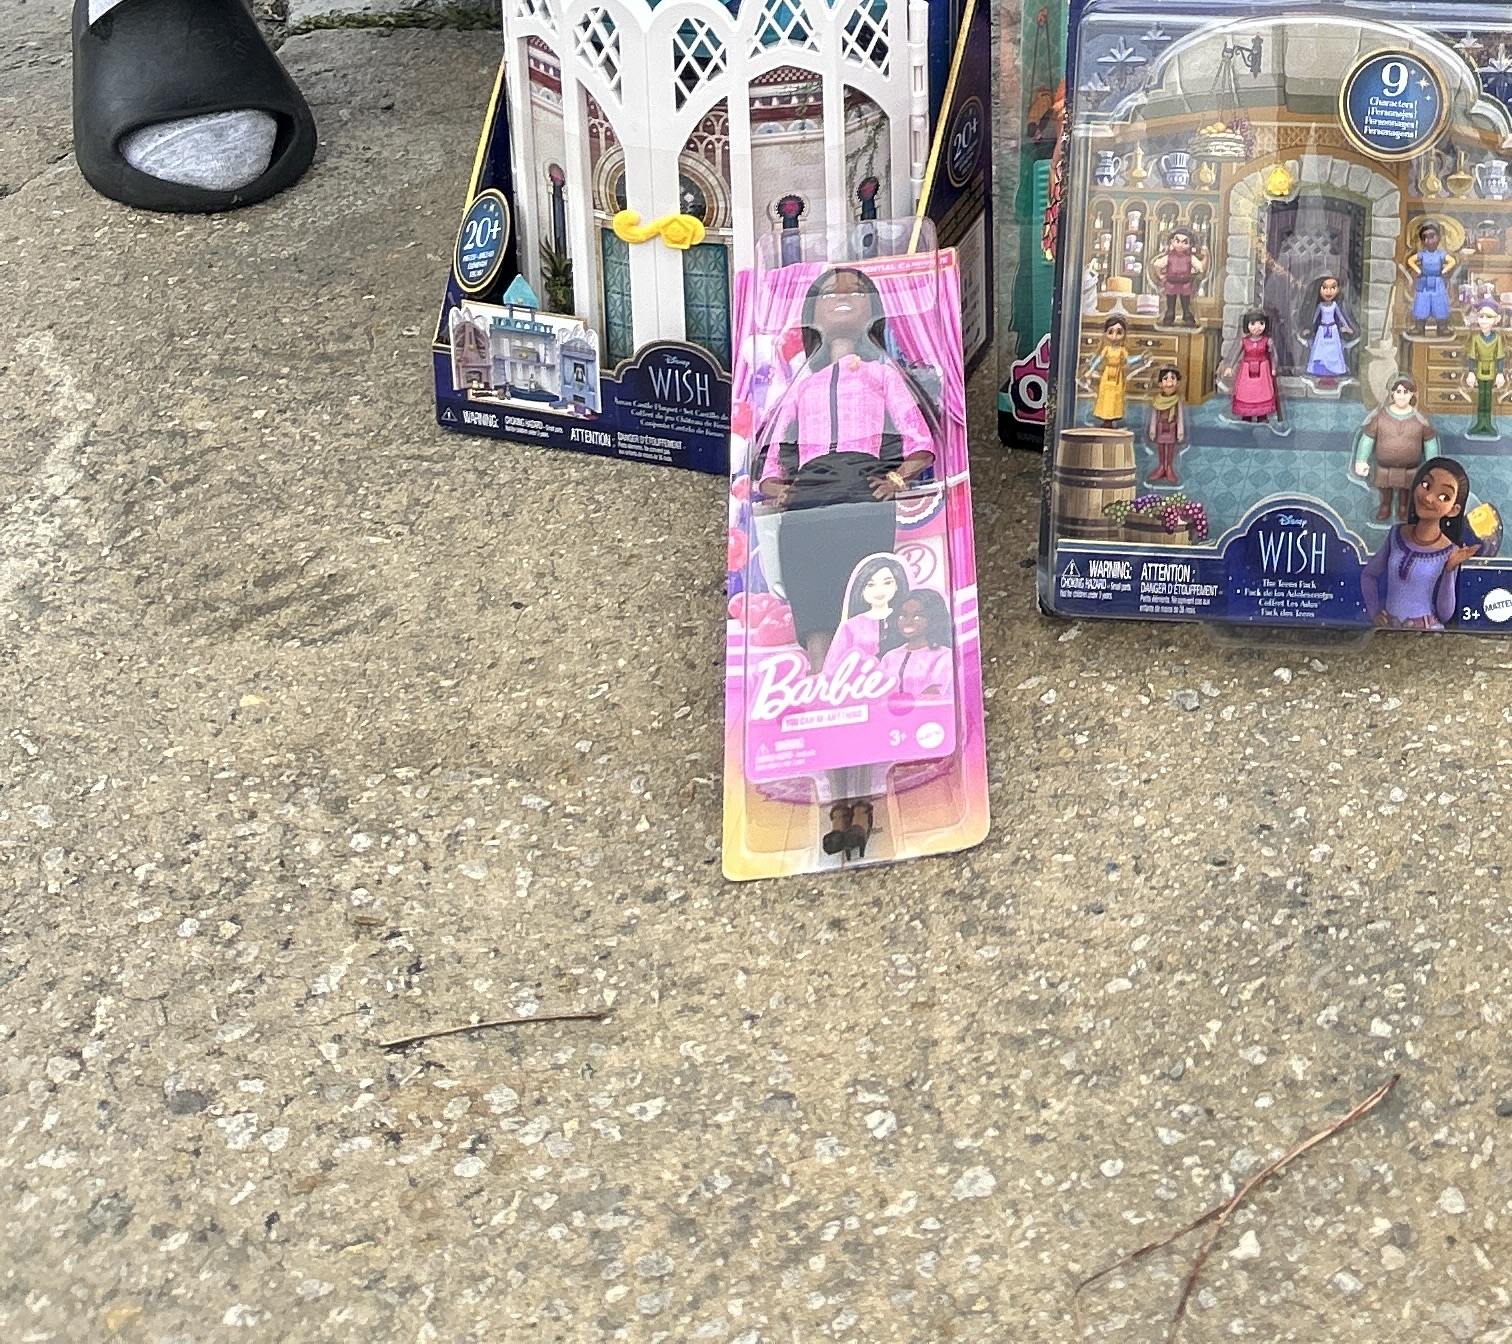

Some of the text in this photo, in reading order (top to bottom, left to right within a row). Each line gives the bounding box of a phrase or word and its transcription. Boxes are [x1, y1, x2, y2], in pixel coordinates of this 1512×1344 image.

[1382, 62, 1408, 97] 9
[463, 217, 501, 250] 20+
[663, 354, 690, 368] Disney
[648, 365, 710, 407] WISH
[463, 410, 499, 428] WARNING:
[570, 427, 611, 447] ATTENTION
[1277, 513, 1308, 528] Disney
[1258, 530, 1326, 574] WISH
[1089, 560, 1132, 579] WARNING:
[1141, 562, 1191, 582] ATTENTION
[1462, 606, 1480, 621] 3+
[751, 651, 897, 720] Barbie
[889, 729, 908, 747] 3+
